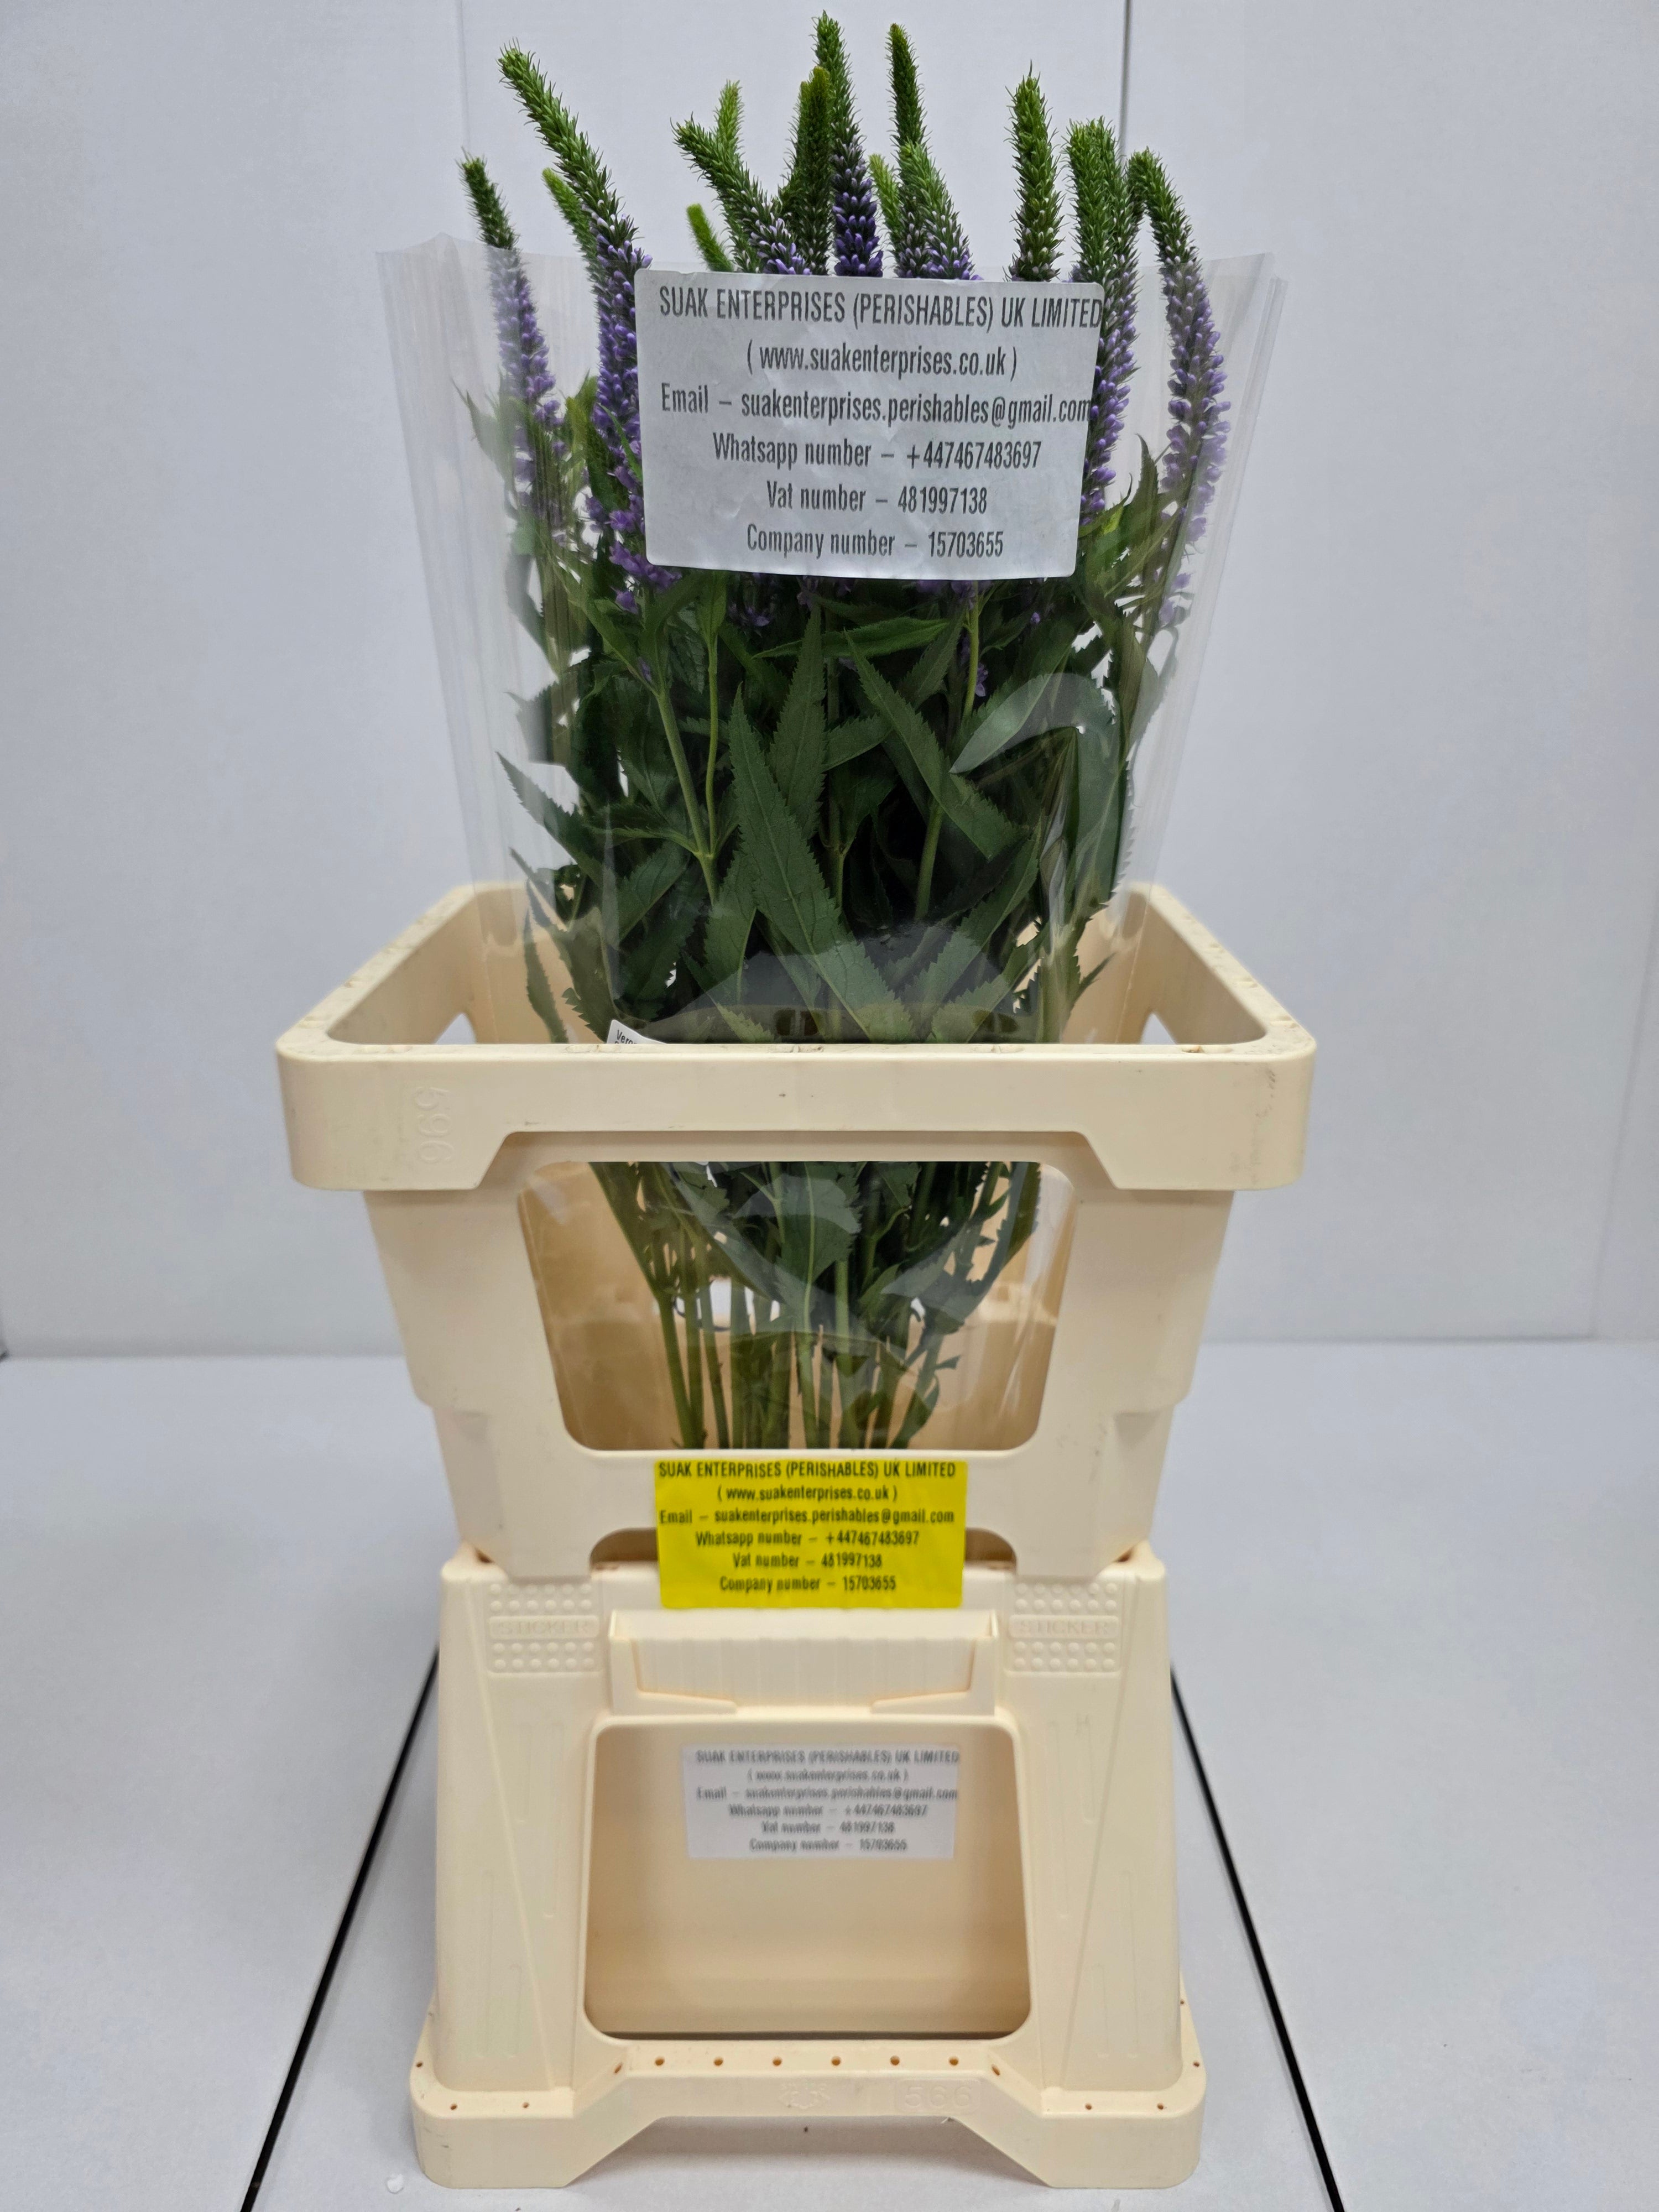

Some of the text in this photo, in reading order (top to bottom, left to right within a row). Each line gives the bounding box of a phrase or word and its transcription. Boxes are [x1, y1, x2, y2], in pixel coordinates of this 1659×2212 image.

[660, 286, 1103, 330] SUAK ENTERPRISES (PERISHABLES) UK LIMITED
[759, 342, 1007, 380] www.suakenterprises.co.uk
[661, 382, 709, 415] Email
[741, 390, 1091, 429] suakenterprises.perishables@gmail.com
[713, 432, 797, 470] Whatsapp
[805, 439, 872, 467] number
[907, 441, 1042, 469] +447467483697
[767, 481, 794, 509] Vat
[801, 486, 866, 512] number
[898, 487, 988, 514] 481997138
[747, 524, 824, 559] Company
[830, 529, 895, 557] number
[928, 531, 1004, 558] 15703655
[616, 1029, 637, 1044] Vero
[659, 1462, 955, 1479] SUAK ENTERPRISES (PERISHABLES) UK LIMITED
[726, 1486, 889, 1502] www.suakenterprises.co.uk
[660, 1510, 692, 1524] Email
[714, 1508, 954, 1525] suakenterprises.perishables@gmail.com
[696, 1532, 753, 1547] Whatsapp
[758, 1532, 802, 1545] number
[733, 1553, 751, 1567] Vat
[755, 1554, 799, 1567] number
[721, 1576, 773, 1593] Company
[777, 1577, 820, 1590] number
[843, 1576, 895, 1591] 15703655
[905, 2084, 973, 2107] 566
